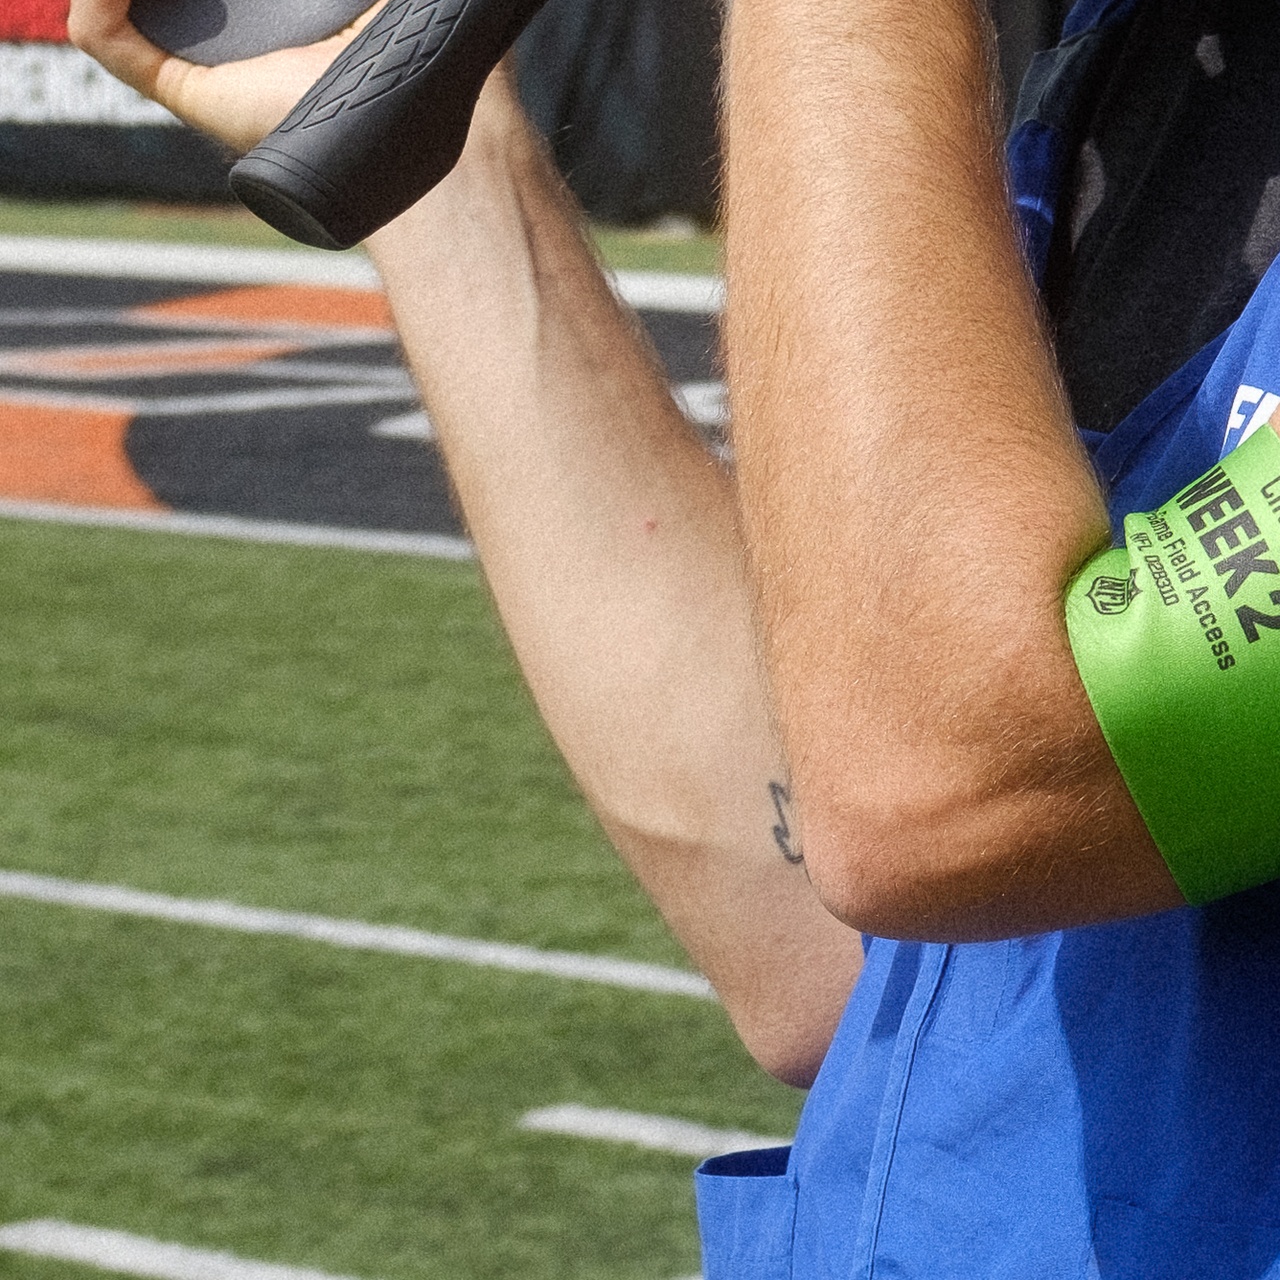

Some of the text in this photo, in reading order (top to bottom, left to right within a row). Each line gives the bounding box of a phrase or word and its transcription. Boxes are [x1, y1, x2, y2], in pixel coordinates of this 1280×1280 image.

[1176, 465, 1280, 599] WEEK
[1163, 537, 1201, 583] Field
[1186, 586, 1236, 671] Access
